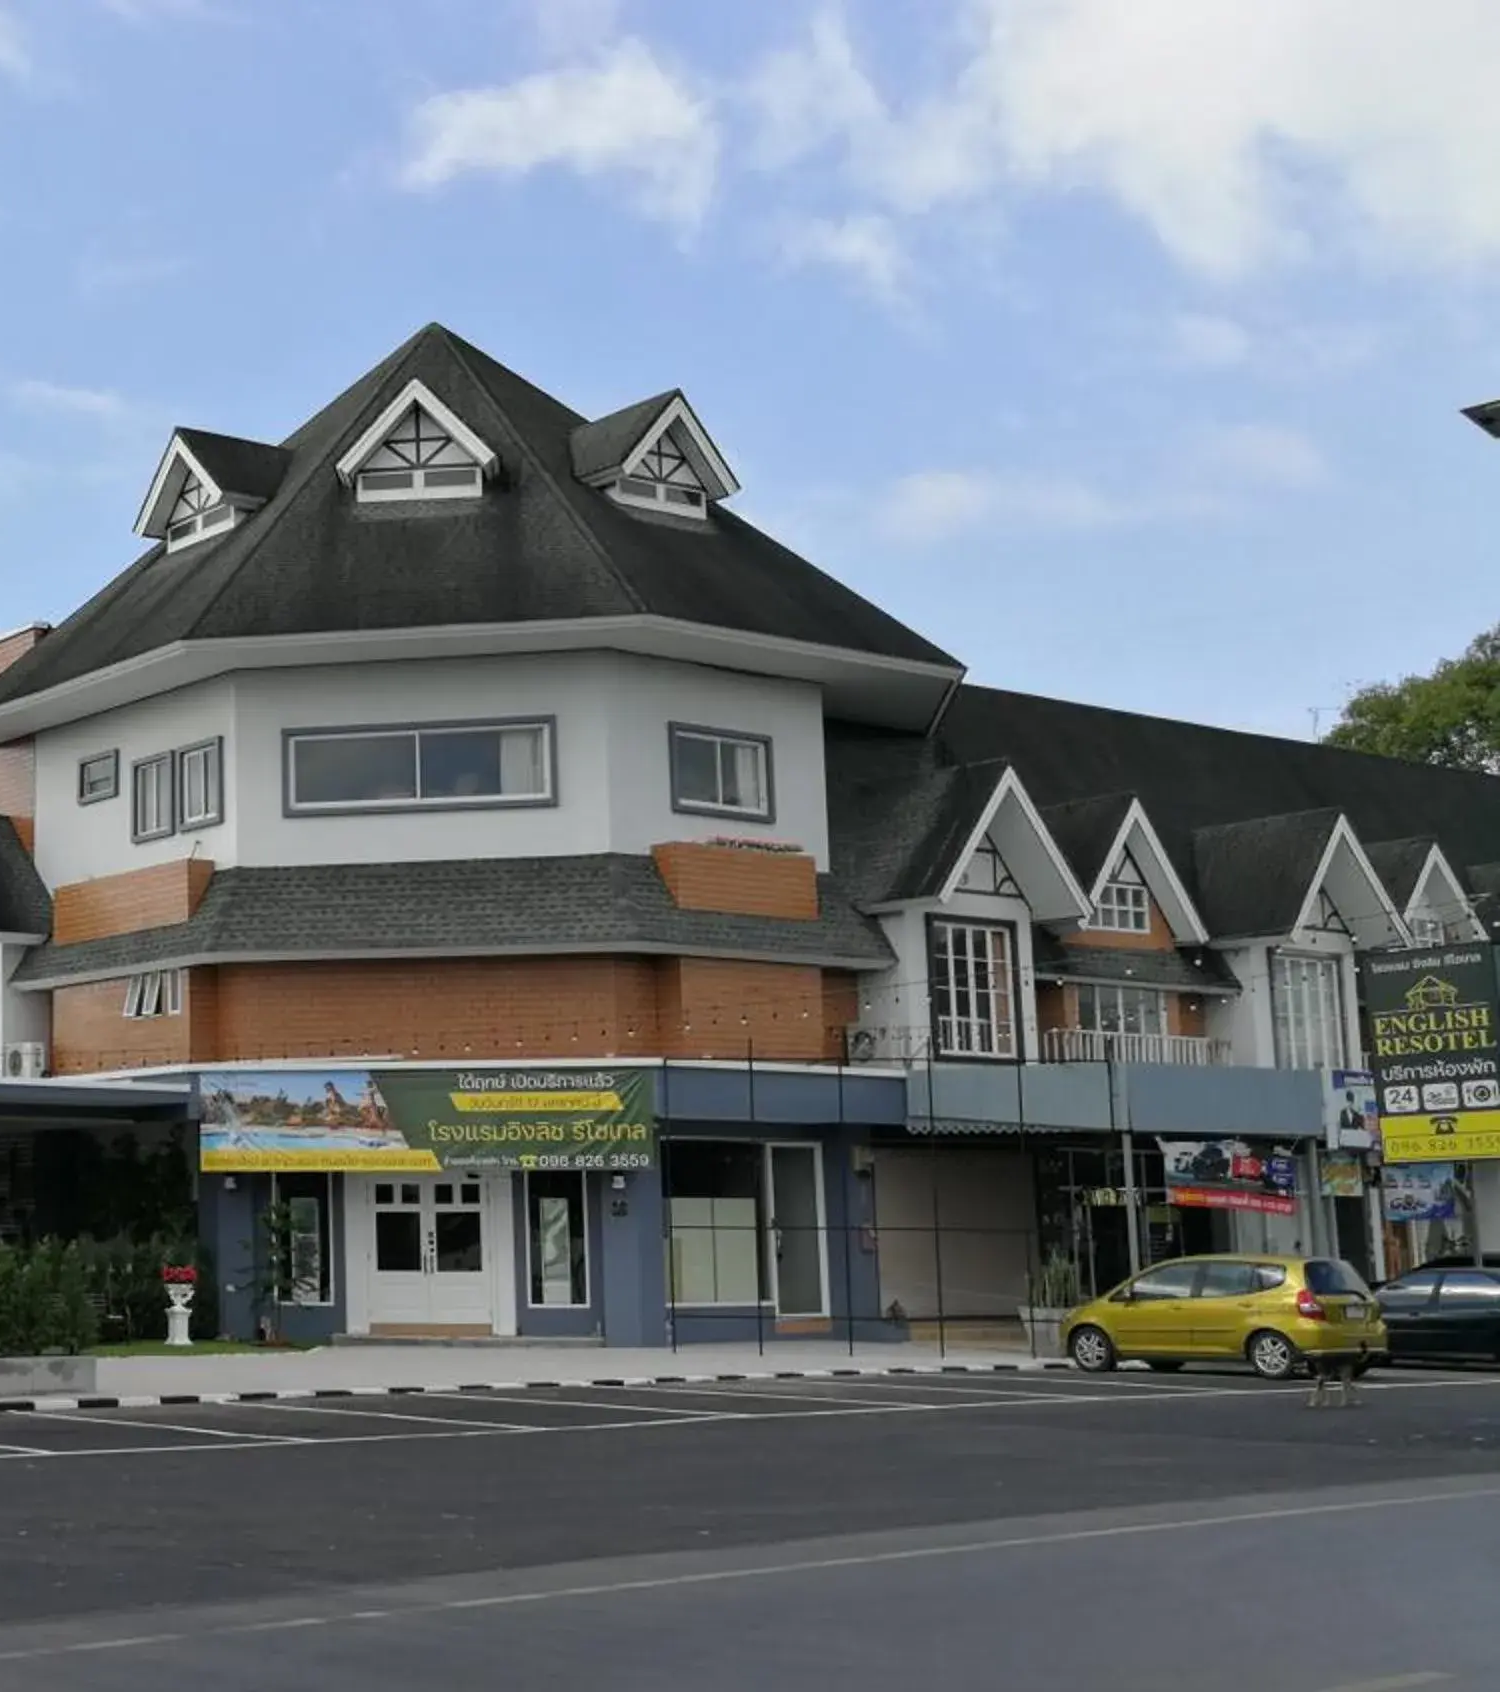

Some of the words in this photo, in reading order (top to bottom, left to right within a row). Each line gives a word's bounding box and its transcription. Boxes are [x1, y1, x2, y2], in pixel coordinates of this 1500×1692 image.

[1374, 1007, 1490, 1036] ENGLISH
[1377, 1030, 1498, 1057] RESOTEL
[1382, 1057, 1497, 1081] บริการห้องพัก
[1389, 1088, 1413, 1105] 24
